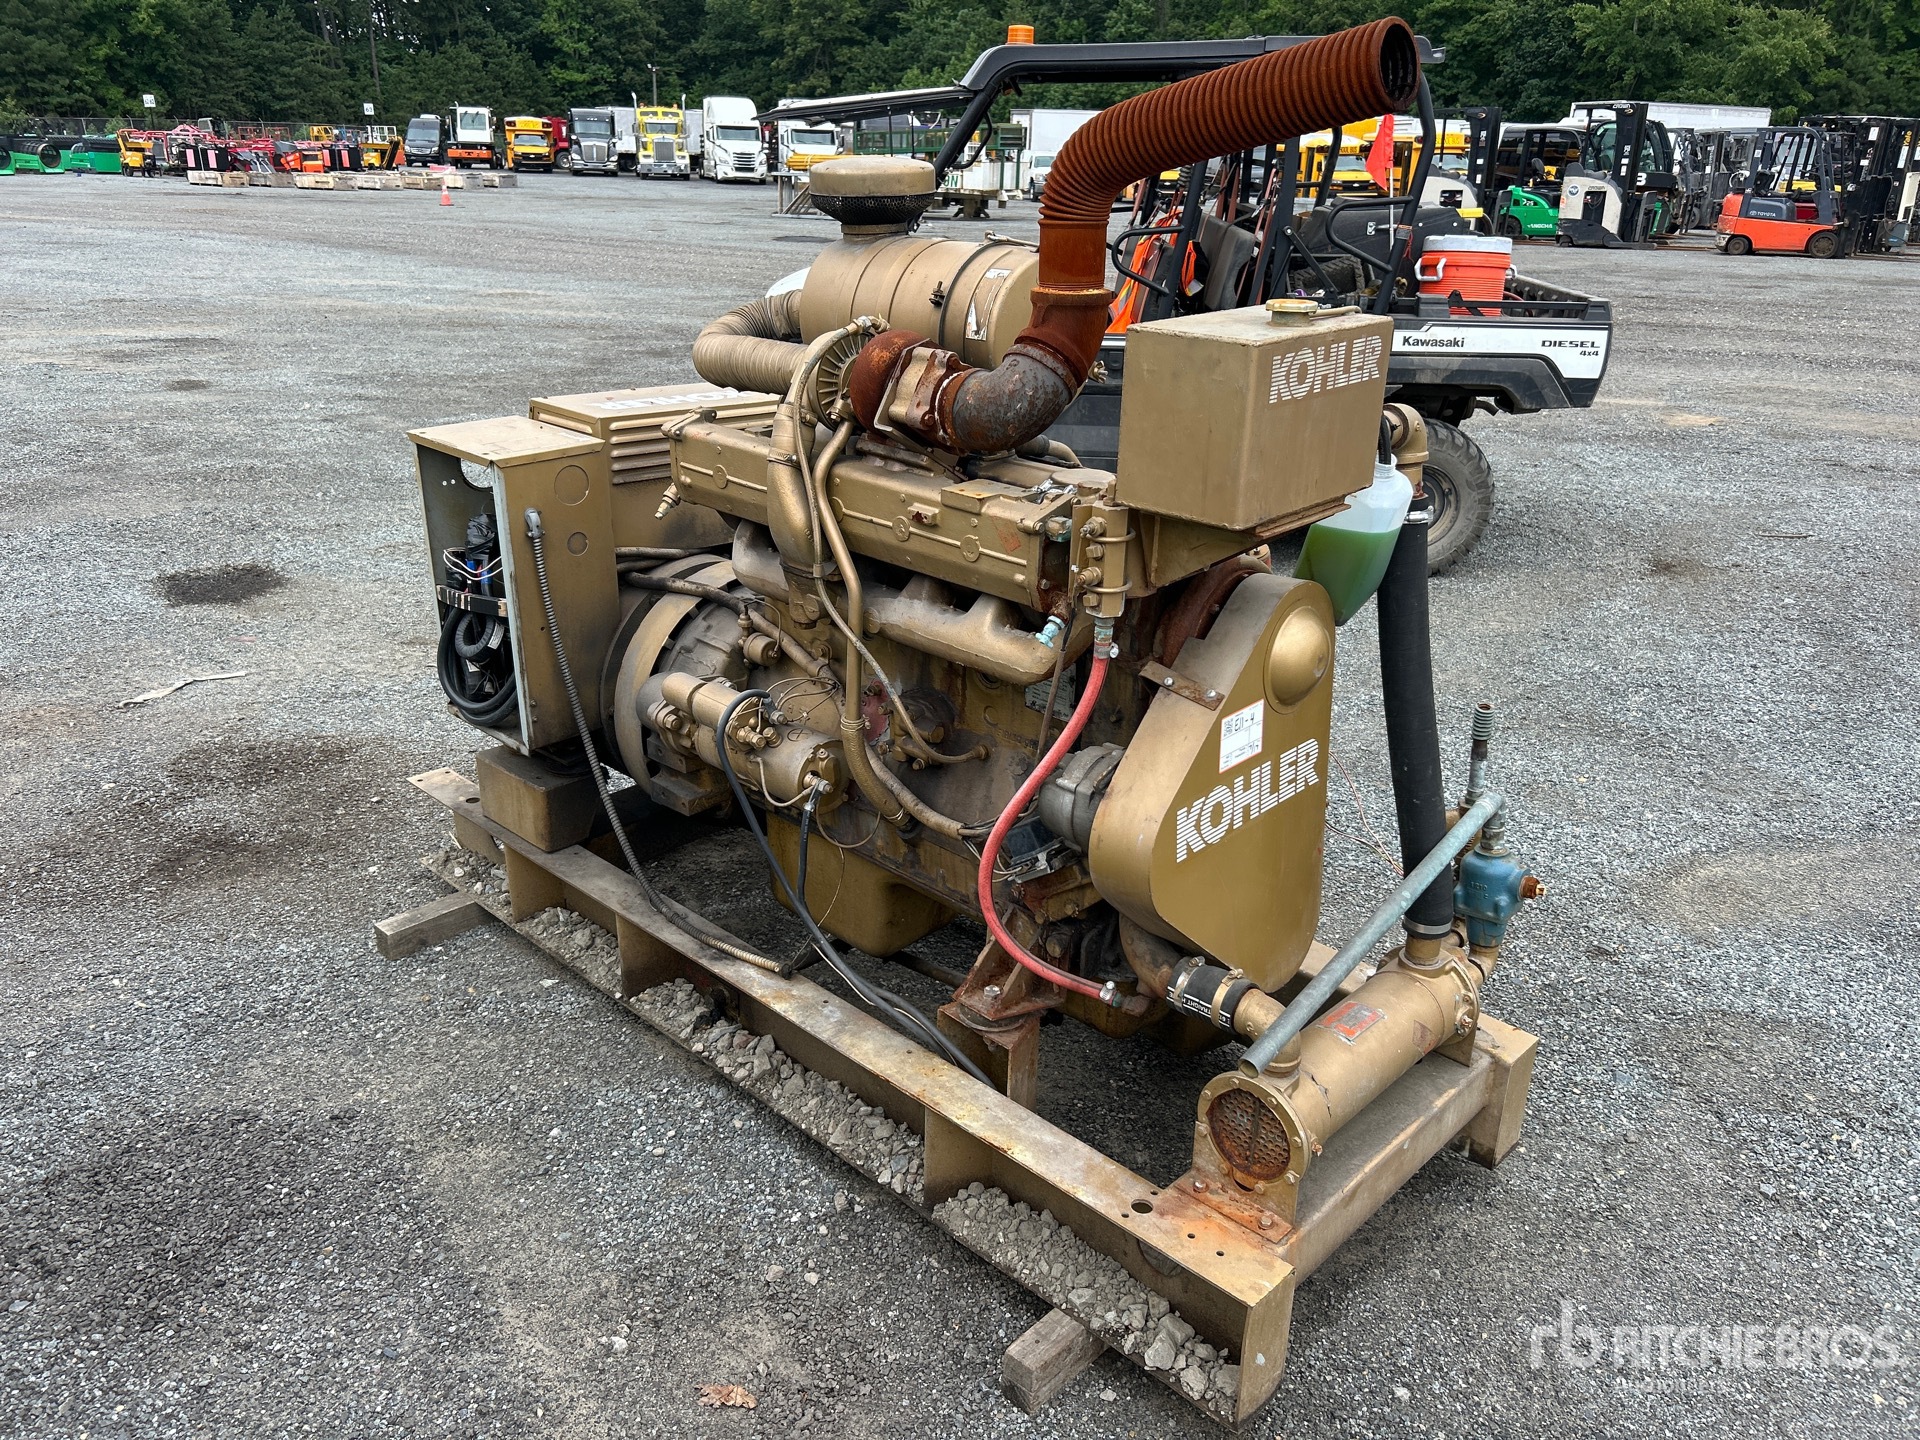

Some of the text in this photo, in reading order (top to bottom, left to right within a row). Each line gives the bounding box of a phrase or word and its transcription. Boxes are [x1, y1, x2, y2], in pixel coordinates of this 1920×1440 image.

[1402, 335, 1465, 348] Kawasaki
[1541, 339, 1600, 348] DIESEL
[1269, 335, 1382, 404] KOHLER
[1176, 738, 1320, 864] KOHLER
